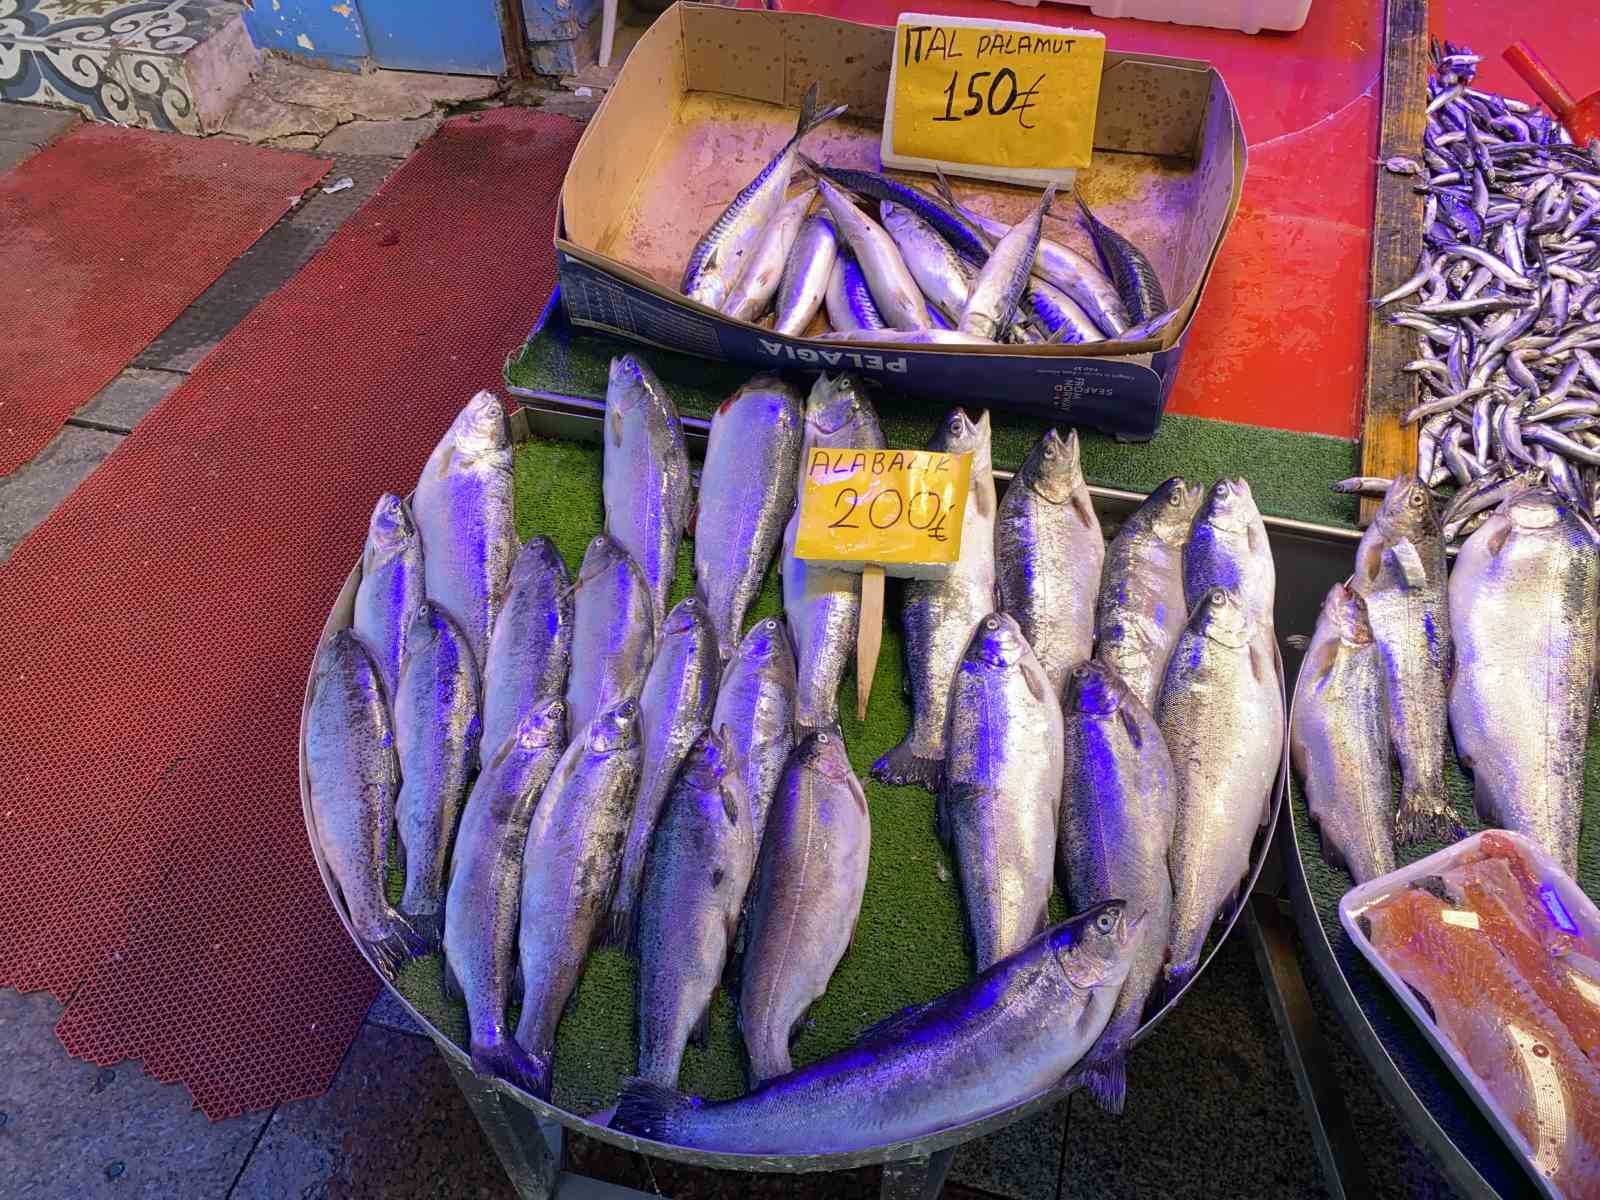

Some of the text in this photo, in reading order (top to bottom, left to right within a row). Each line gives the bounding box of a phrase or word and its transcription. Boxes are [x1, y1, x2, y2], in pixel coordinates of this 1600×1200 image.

[905, 26, 1077, 68] ITAL PALAMUT
[759, 338, 909, 374] PELAGIA
[809, 450, 951, 476] ALABALIK
